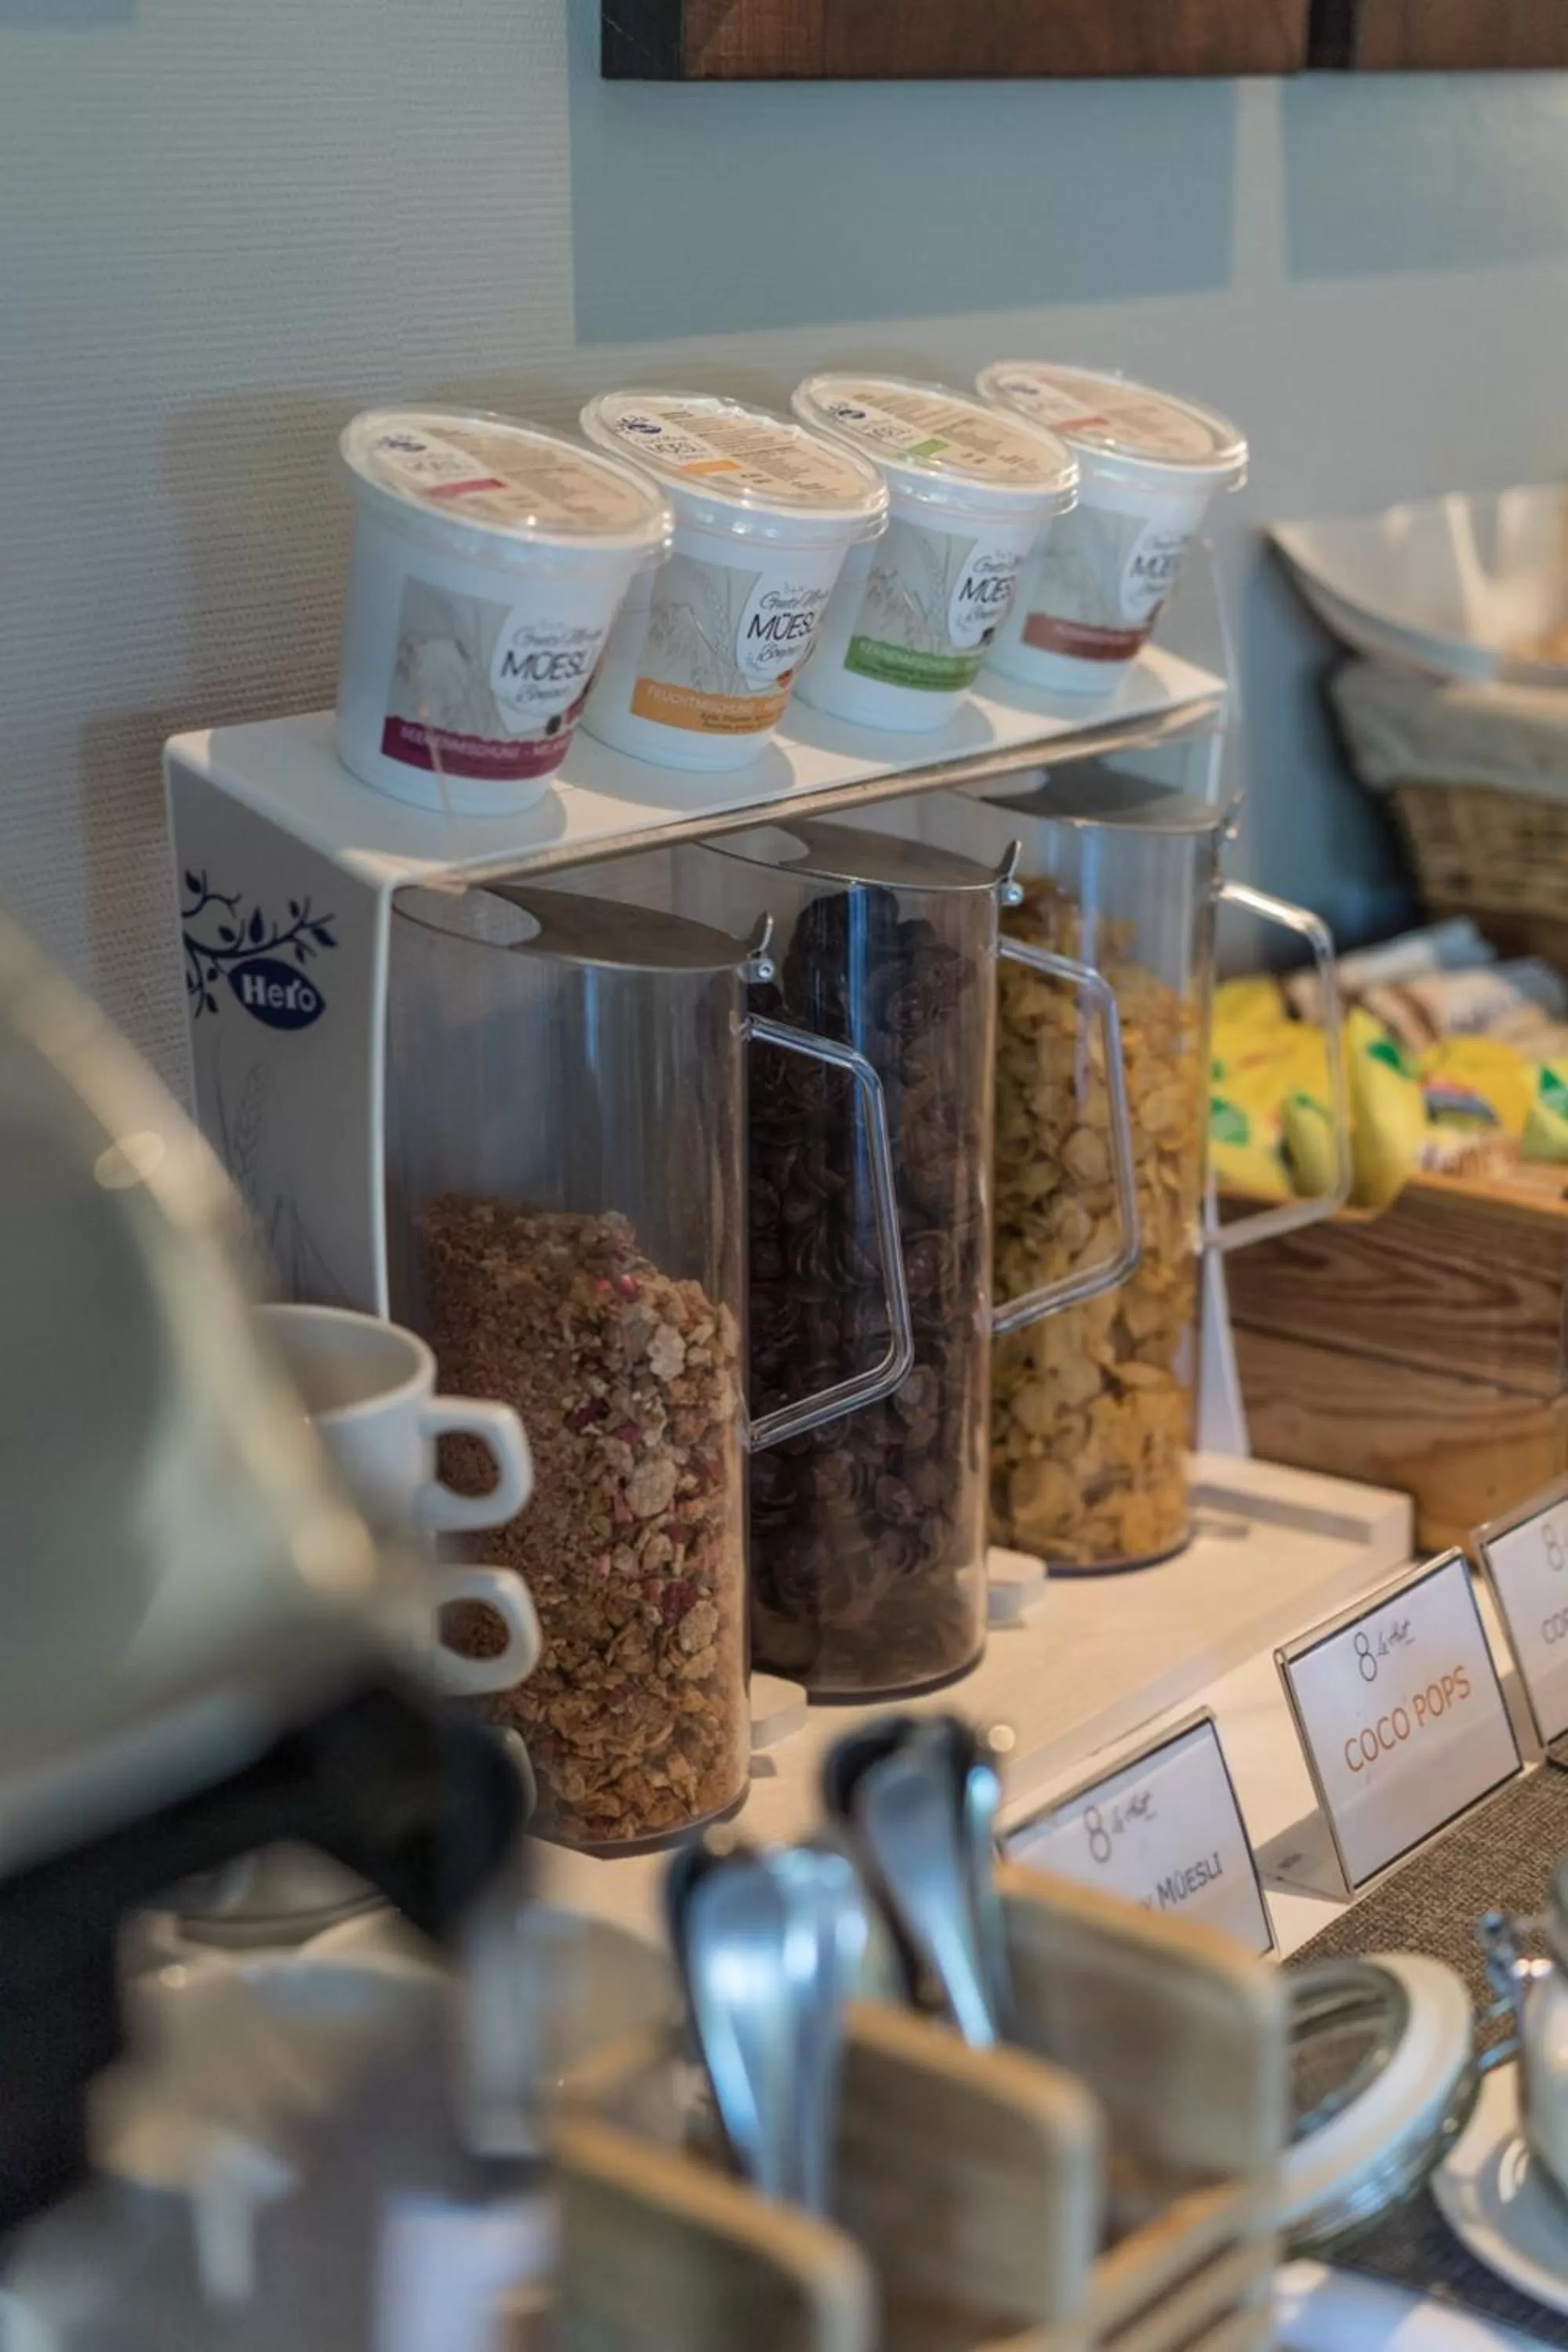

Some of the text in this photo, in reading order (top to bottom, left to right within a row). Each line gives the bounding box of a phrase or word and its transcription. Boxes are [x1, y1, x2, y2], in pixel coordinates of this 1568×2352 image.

[241, 973, 317, 1013] Hero
[1354, 1631, 1377, 1682] 8
[1345, 1664, 1472, 1772] COCO POPS
[1083, 1805, 1112, 1864] 8
